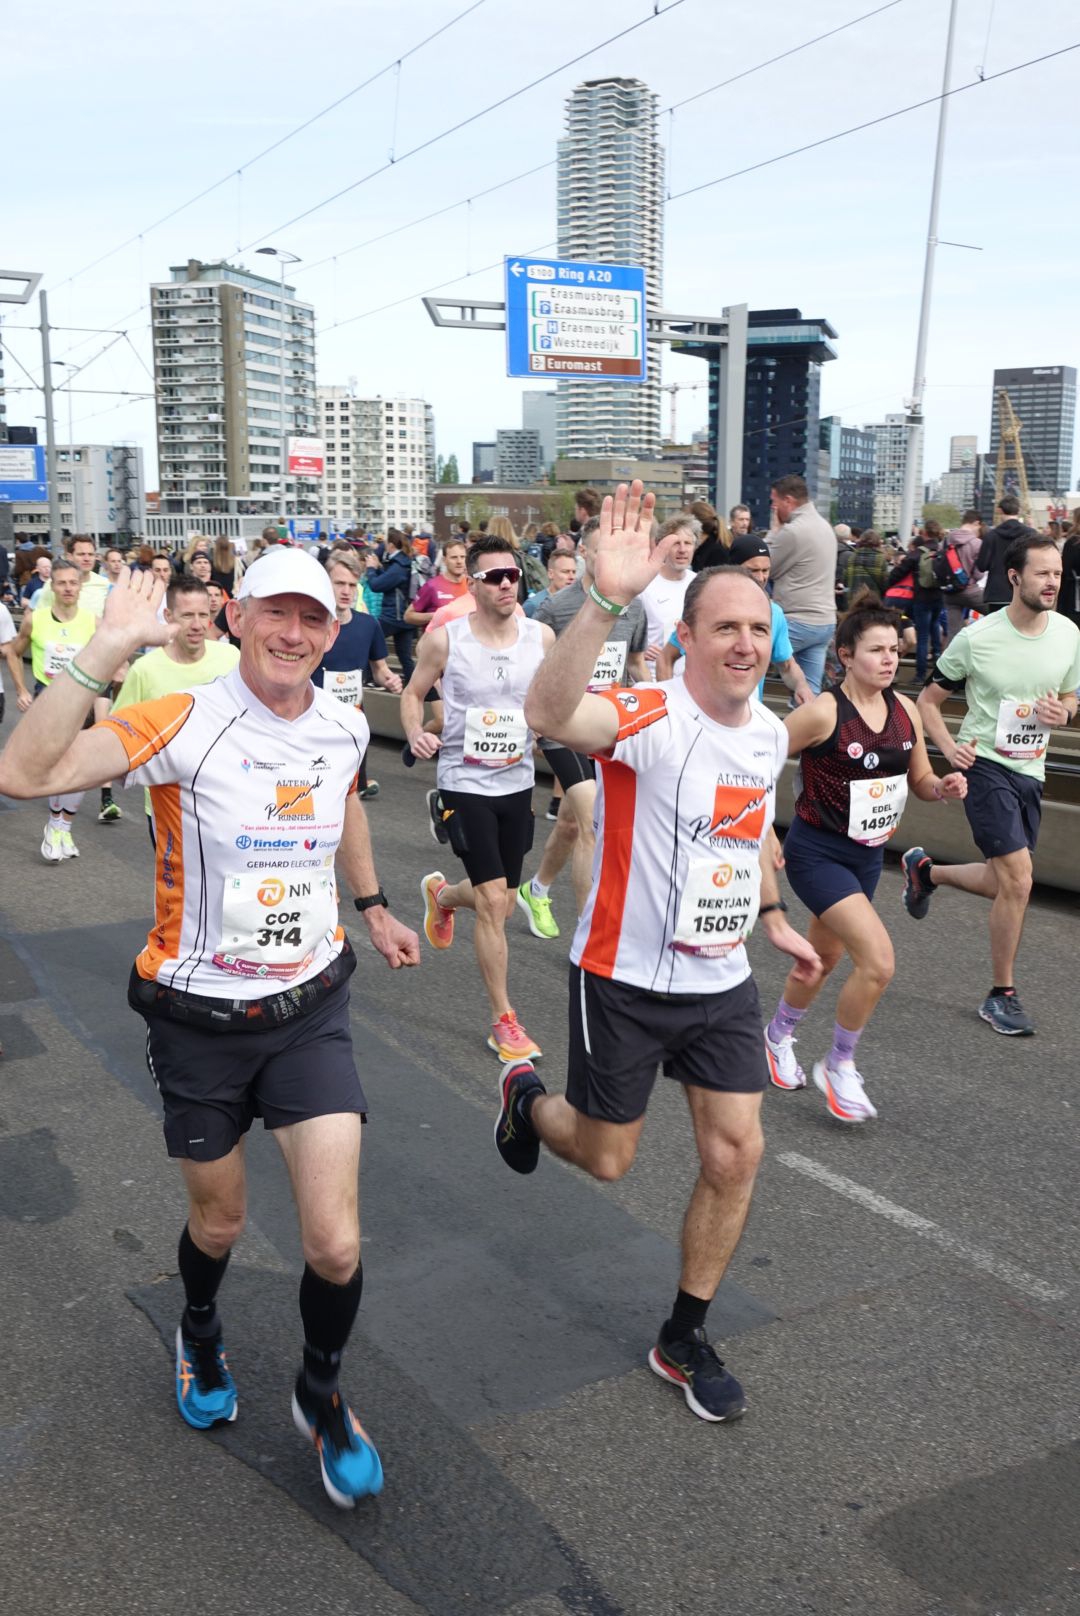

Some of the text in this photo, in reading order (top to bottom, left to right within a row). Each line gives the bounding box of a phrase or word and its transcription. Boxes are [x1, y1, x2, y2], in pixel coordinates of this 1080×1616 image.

[558, 267, 584, 283] Ring
[587, 269, 612, 283] A20
[551, 288, 622, 305] Erasmusbrug
[554, 303, 625, 319] Erasmusbrug
[561, 322, 605, 335] Erasmus
[609, 325, 625, 336] MC
[553, 337, 620, 352] Westzeedijk
[547, 358, 602, 372] Euromast
[1006, 733, 1043, 745] 16672
[473, 741, 517, 753] 10720
[872, 803, 892, 814] EDEL
[860, 813, 898, 831] 14927
[253, 839, 298, 847] finder
[291, 859, 321, 868] ELECTRO
[734, 869, 751, 879] NN
[289, 882, 311, 898] NN
[697, 897, 751, 909] BERTJAN
[266, 912, 301, 925] COR
[693, 914, 748, 933] 15057
[256, 927, 302, 947] 314
